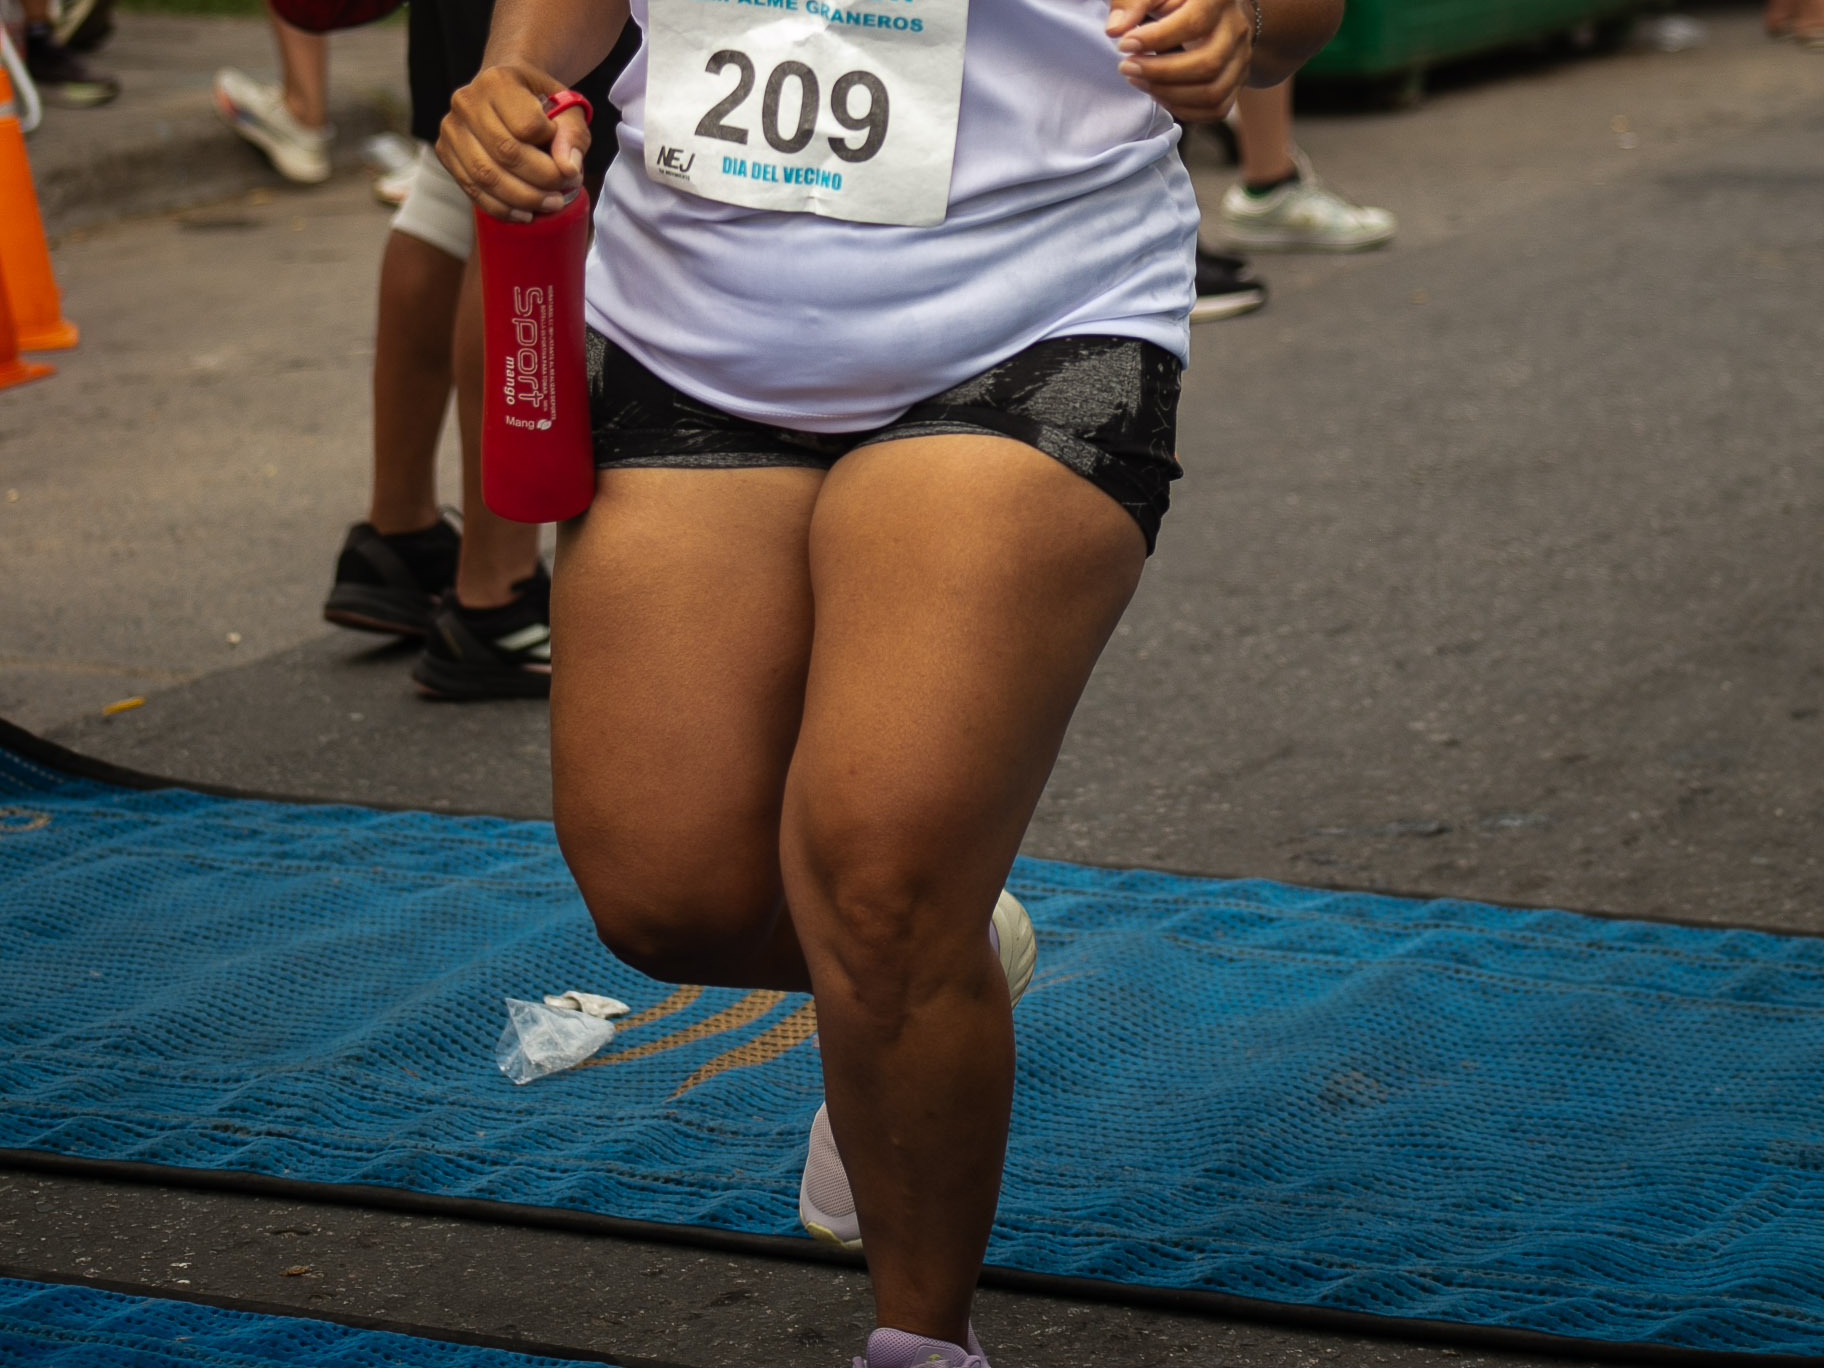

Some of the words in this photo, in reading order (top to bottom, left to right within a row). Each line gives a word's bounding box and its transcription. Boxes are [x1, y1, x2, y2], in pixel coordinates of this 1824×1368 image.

[694, 48, 890, 164] 209
[656, 144, 696, 173] NEJ
[722, 155, 748, 177] DIA
[751, 161, 780, 182] DEL
[782, 167, 843, 191] VECINO
[511, 285, 544, 408] Sport
[504, 356, 516, 405] mango
